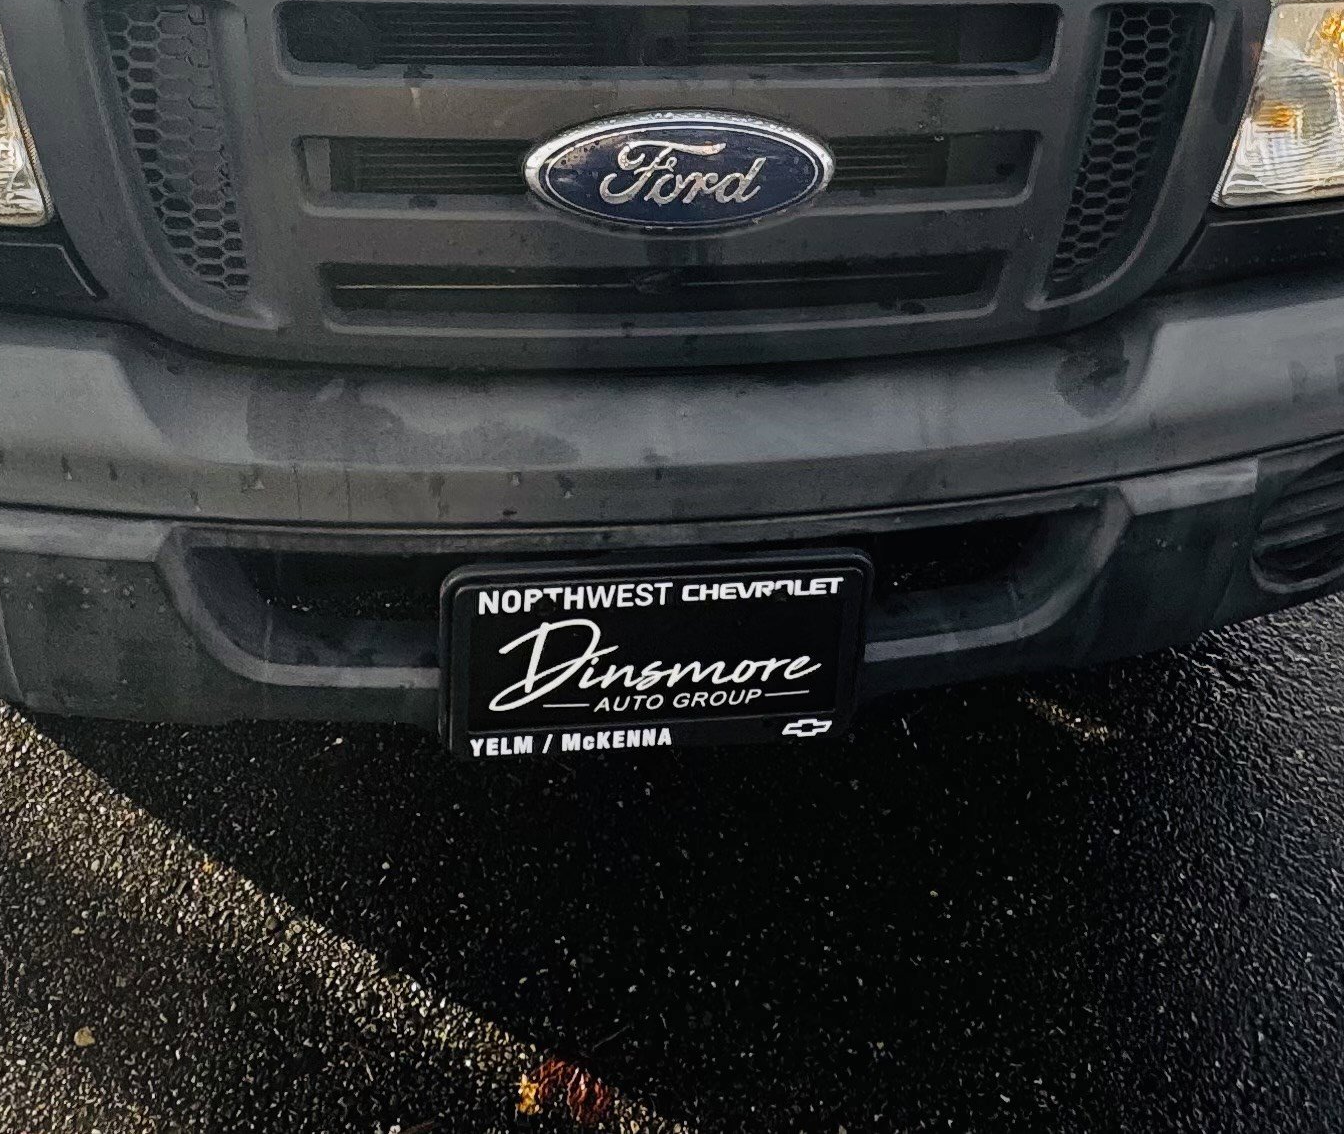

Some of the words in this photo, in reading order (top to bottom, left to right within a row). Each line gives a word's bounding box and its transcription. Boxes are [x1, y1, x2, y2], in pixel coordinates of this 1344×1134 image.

[599, 140, 767, 205] Ford
[478, 582, 673, 615] NORTHWEST
[682, 577, 844, 601] CHEVROLET
[488, 618, 823, 712] Dinsmore
[594, 695, 664, 712] AUTO
[672, 689, 762, 708] GROUP
[470, 735, 533, 757] YELM
[542, 734, 553, 753] /
[561, 728, 672, 751] McKENNA
